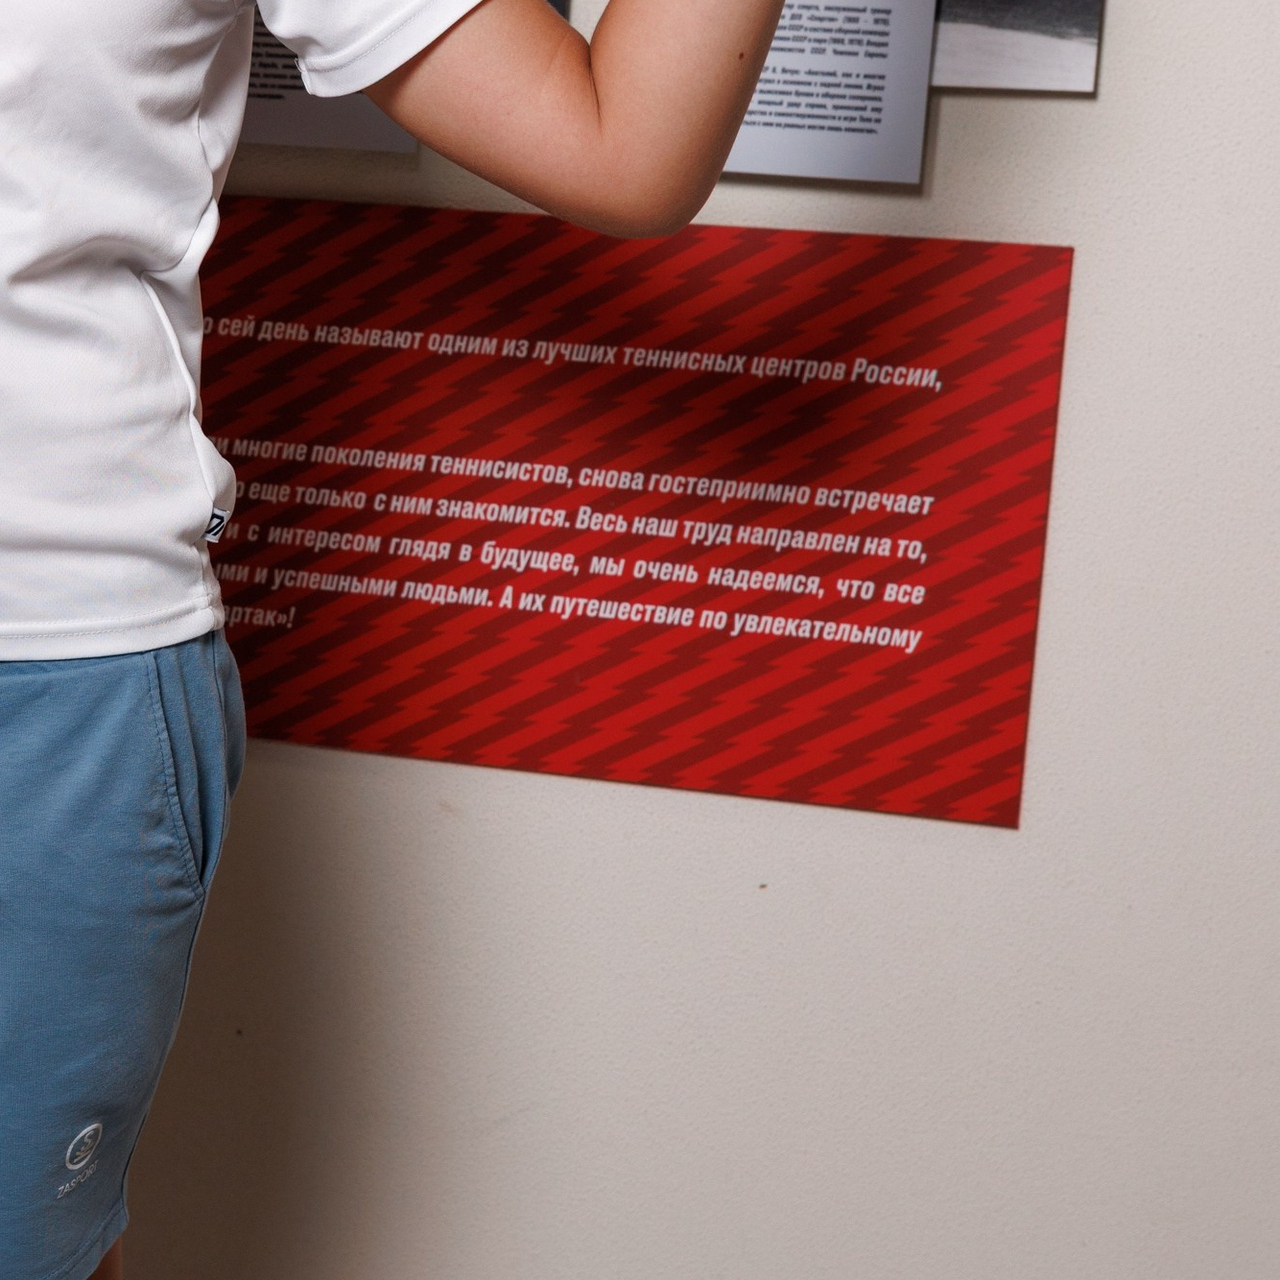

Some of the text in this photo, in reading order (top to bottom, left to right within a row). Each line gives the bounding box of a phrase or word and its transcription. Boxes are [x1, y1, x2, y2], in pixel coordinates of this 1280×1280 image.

[218, 315, 255, 337] сей
[258, 320, 309, 341] день
[315, 325, 424, 349] называют
[428, 333, 497, 356] одним
[502, 339, 528, 358] из
[533, 341, 618, 365] лучших
[624, 347, 746, 373] теннисных
[751, 356, 846, 384] центров
[852, 358, 942, 392] России,
[233, 440, 307, 462] многие
[311, 445, 426, 471] поколения
[431, 455, 572, 488] теннисистов,
[579, 467, 643, 491] снова
[649, 473, 811, 504] гостеприимно
[815, 487, 934, 515] встречает
[249, 482, 290, 503] еще
[296, 487, 366, 510] только
[374, 493, 387, 511] с
[390, 495, 433, 516] ним
[436, 498, 570, 528] знакомится.
[576, 506, 627, 533] Весь
[631, 517, 678, 538] наш
[683, 520, 733, 546] труд
[737, 526, 860, 554] направлен
[863, 538, 892, 556] на
[897, 539, 927, 564] то,
[247, 524, 925, 605] с интересом глядя в будущее, мы очень надеемся, что все
[254, 568, 268, 584] и
[271, 569, 397, 598] успешными
[401, 581, 493, 608] людьми.
[499, 586, 514, 609] А
[519, 592, 546, 612] их
[550, 595, 695, 628] путешествие
[699, 610, 727, 630] по
[731, 612, 922, 654] увлекательному
